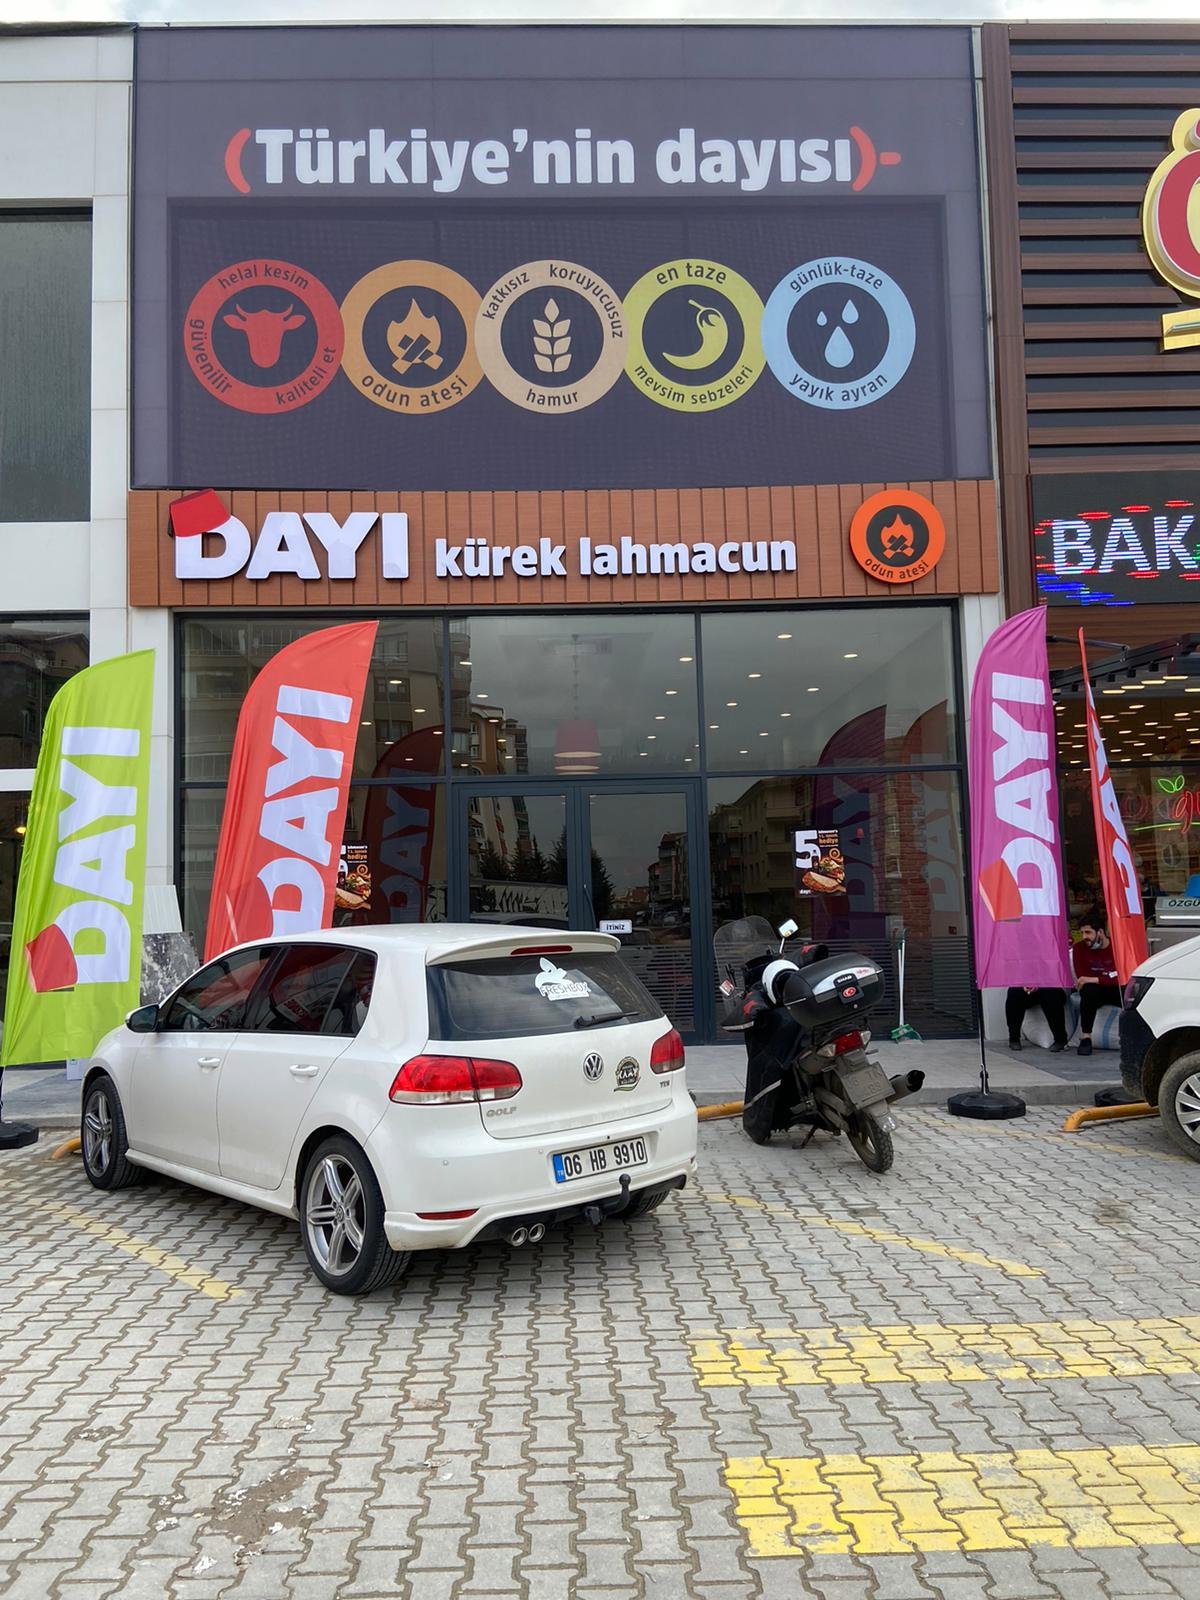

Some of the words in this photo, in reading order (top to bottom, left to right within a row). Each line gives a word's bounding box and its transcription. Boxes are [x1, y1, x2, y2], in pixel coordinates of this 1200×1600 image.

[217, 264, 258, 290] helal
[264, 264, 309, 290] kesim
[656, 267, 679, 285] en
[686, 262, 727, 285] taze
[790, 262, 883, 293] günlük-taze
[482, 272, 531, 320] katkısız
[549, 264, 624, 339] koruyucusuz
[190, 319, 232, 394] güvenilir
[276, 364, 329, 405] kaliteli
[325, 346, 337, 365] et
[361, 374, 410, 407] odun
[420, 374, 469, 407] ateşi
[634, 364, 686, 404] mevsim
[690, 365, 753, 404] sebzeleri
[789, 373, 834, 401] yayık
[841, 374, 888, 402] ayran
[526, 388, 579, 406] hamur
[175, 511, 409, 580] DAYI
[435, 537, 566, 577] kürek
[579, 536, 797, 576] lahmacun
[865, 558, 894, 579] odun
[899, 560, 929, 579] ateşi
[257, 685, 353, 937] DAYI
[991, 671, 1061, 918] DAYI
[53, 726, 141, 985] DAYI
[795, 830, 821, 868] 5
[486, 1106, 517, 1118] GOLF
[564, 1154, 582, 1177] 06
[589, 1149, 607, 1171] HB
[613, 1141, 645, 1165] 9910
